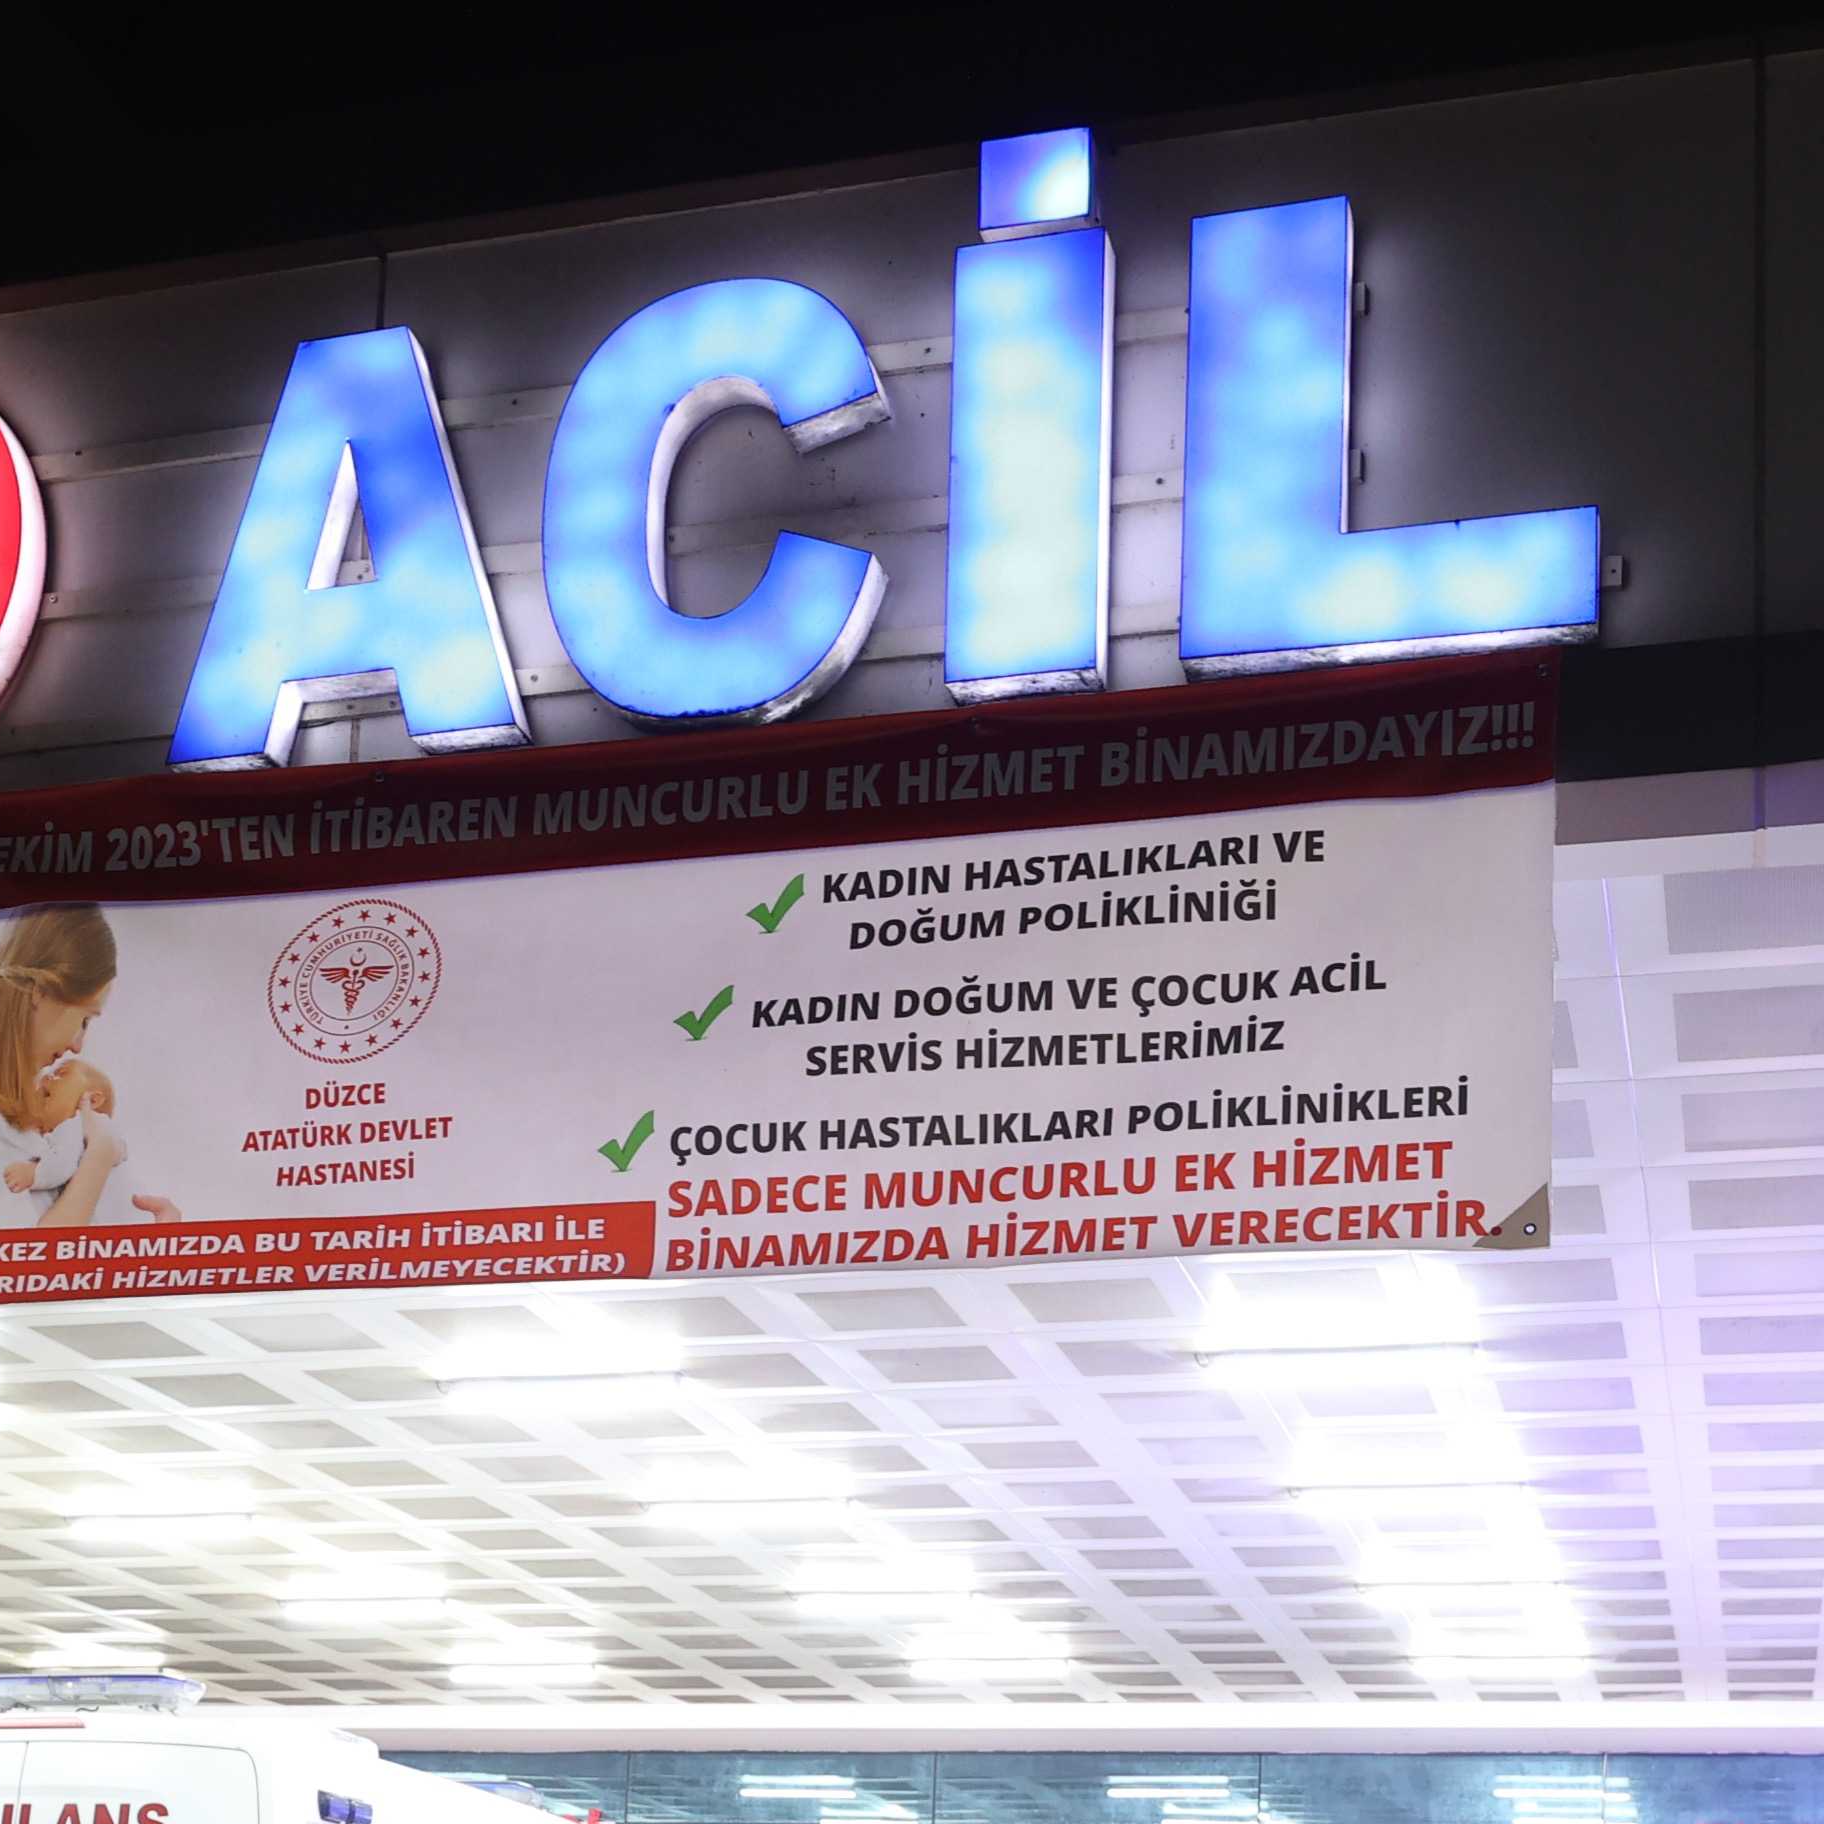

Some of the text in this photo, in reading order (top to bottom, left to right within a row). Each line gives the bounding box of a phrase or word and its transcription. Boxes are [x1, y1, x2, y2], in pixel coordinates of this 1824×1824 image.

[166, 125, 1601, 769] ACİL
[105, 813, 295, 872] 2023'TEN
[310, 796, 517, 855] İTİBAREN
[532, 768, 809, 836] MUNCURLU
[825, 761, 884, 812] EK
[897, 743, 1086, 804] HİZMET
[1100, 701, 1536, 789] BİNAMIZDAYIZ!!!
[821, 829, 1326, 904] KADIN HASTALIKLARI VE
[848, 879, 1278, 949] DOĞUM POLİKLİNİĞİ
[751, 951, 1387, 1028] KADIN DOĞUM VE ÇOCUK ACİL
[805, 1014, 1286, 1077] SERVİS HİZMETLERİMİZ
[305, 1080, 386, 1110] DÜZCE
[669, 1075, 1469, 1167] ÇOCUK HASTALIKLARI POLİKLİNİKLERİ
[241, 1116, 453, 1153] ATATÜRK DEVLET
[276, 1151, 415, 1187] HASTANESİ
[667, 1137, 1454, 1218] SADECE MUNCURLU EK HİZMET
[55, 1234, 248, 1261] BİNAMIZDA
[255, 1232, 300, 1253] BU
[310, 1223, 412, 1252] TARİH
[421, 1219, 544, 1248] İTİBARI
[554, 1214, 606, 1241] İLE
[664, 1189, 1503, 1272] BİNAMIZDA HİZMET VERECEKTİR.
[111, 1264, 295, 1289] HİZMETLER
[305, 1248, 626, 1284] VERİLMEYECEKTİR)
